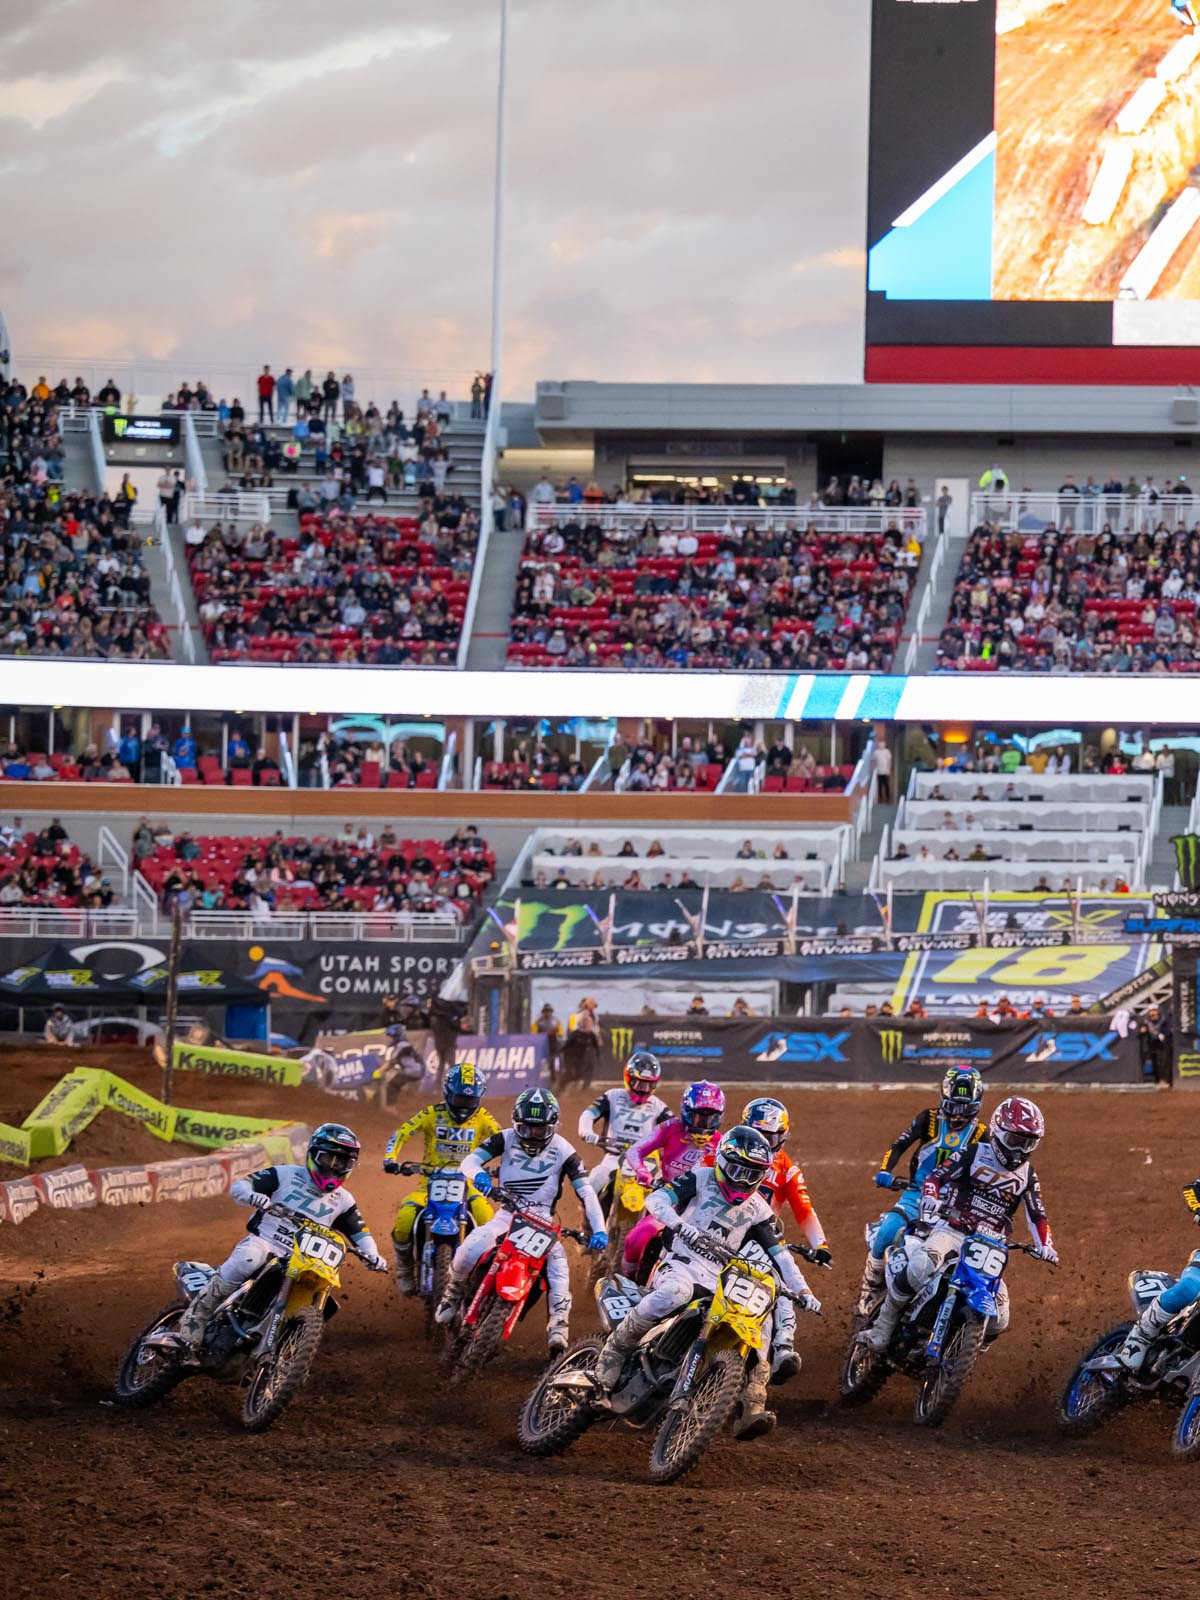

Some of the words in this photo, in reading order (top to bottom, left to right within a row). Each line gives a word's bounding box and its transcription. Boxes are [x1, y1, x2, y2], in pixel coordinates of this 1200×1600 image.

[320, 955, 380, 973] UTAH
[390, 955, 465, 974] SPORT
[931, 946, 1130, 985] 18
[319, 976, 428, 996] COMMISS
[924, 992, 1100, 1005] LAWRENC
[178, 1051, 287, 1084] Kawasaki
[455, 1046, 535, 1071] YAMAHA
[107, 1083, 169, 1135] Kawasaki
[613, 1108, 652, 1124] FLY
[175, 1113, 264, 1141] Kawas
[510, 1154, 553, 1174] FLY
[283, 1190, 335, 1218] FLY
[430, 1182, 467, 1201] 69
[700, 1196, 752, 1228] FLY
[272, 1234, 294, 1248] SUZ
[300, 1232, 344, 1268] 100
[507, 1225, 553, 1259] 48
[965, 1242, 1008, 1277] 36
[723, 1272, 771, 1317] 128
[266, 1314, 280, 1347] DUNLOP
[684, 1353, 701, 1391] DUNLOP
